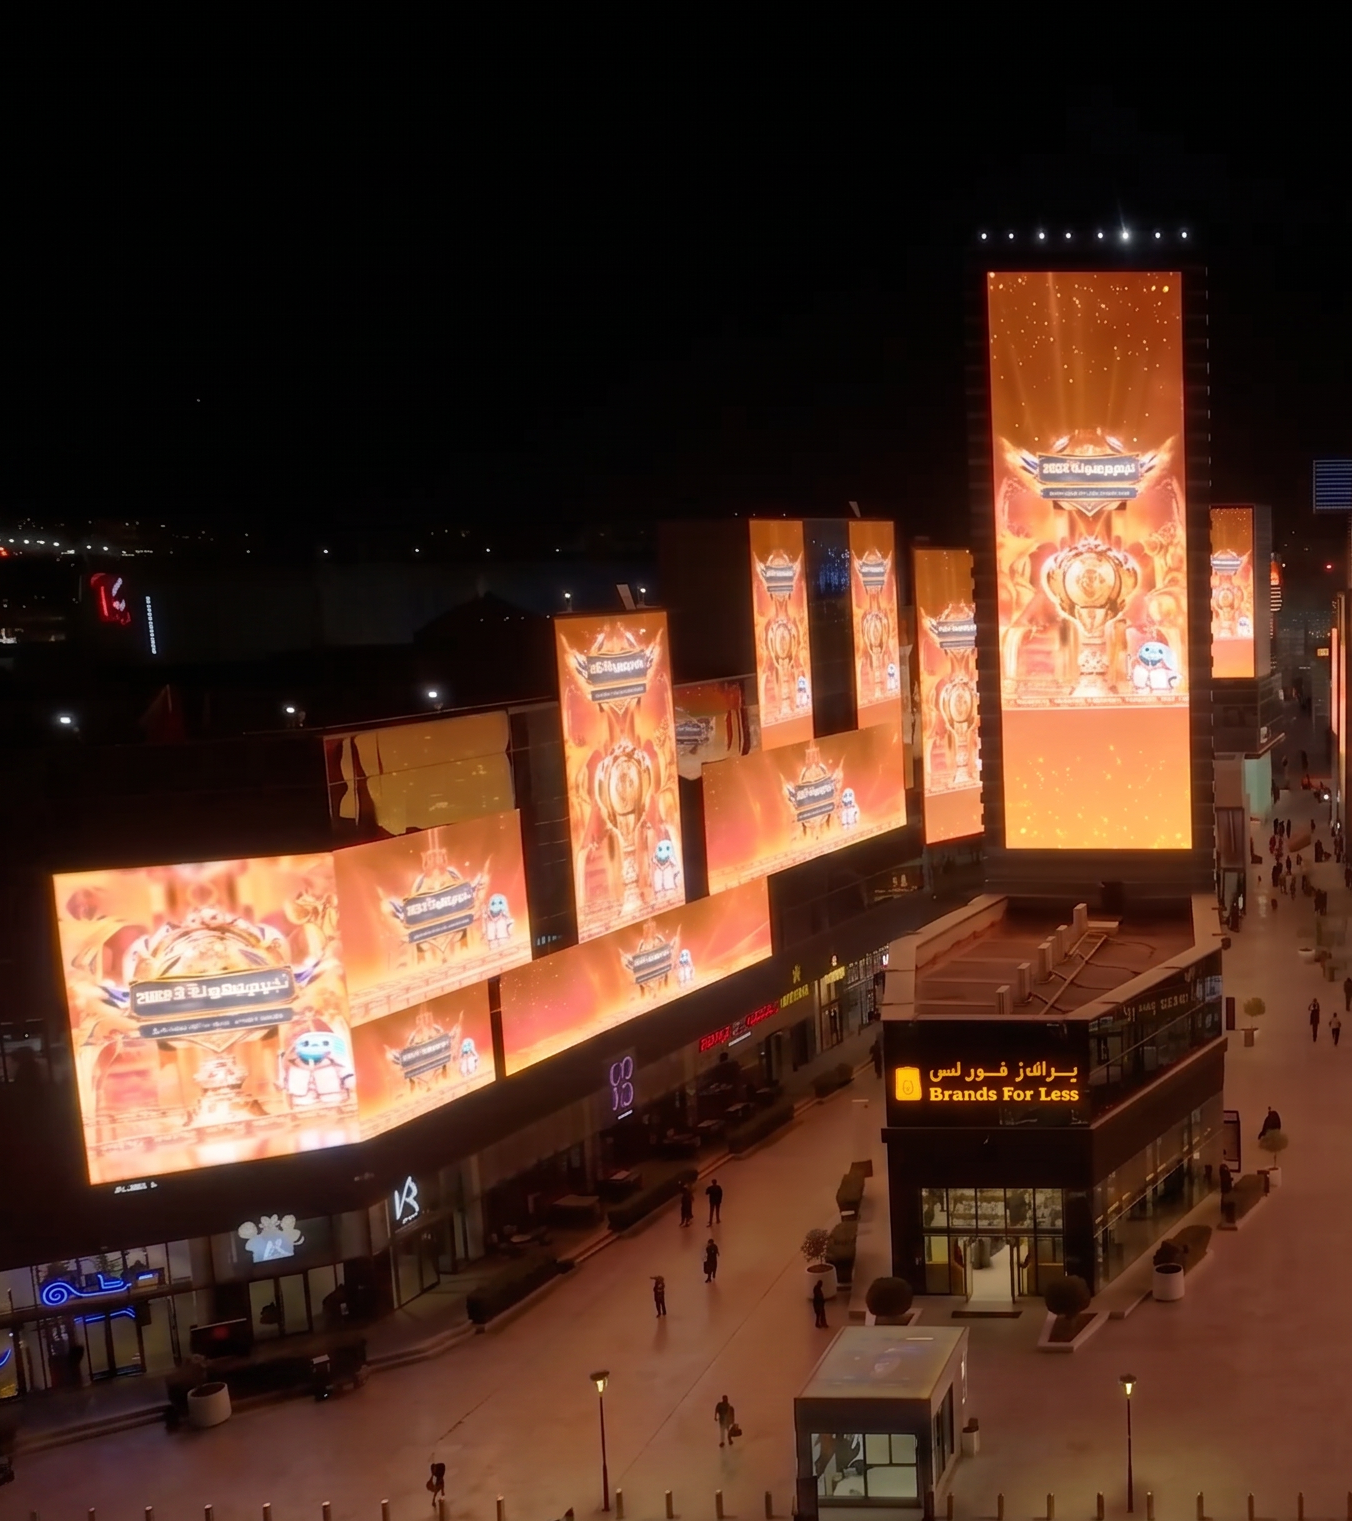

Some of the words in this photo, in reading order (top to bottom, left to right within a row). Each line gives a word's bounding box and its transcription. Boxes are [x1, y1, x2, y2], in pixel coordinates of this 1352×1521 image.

[929, 1086, 998, 1102] Brands
[1002, 1086, 1034, 1102] For
[1039, 1087, 1080, 1102] Less
